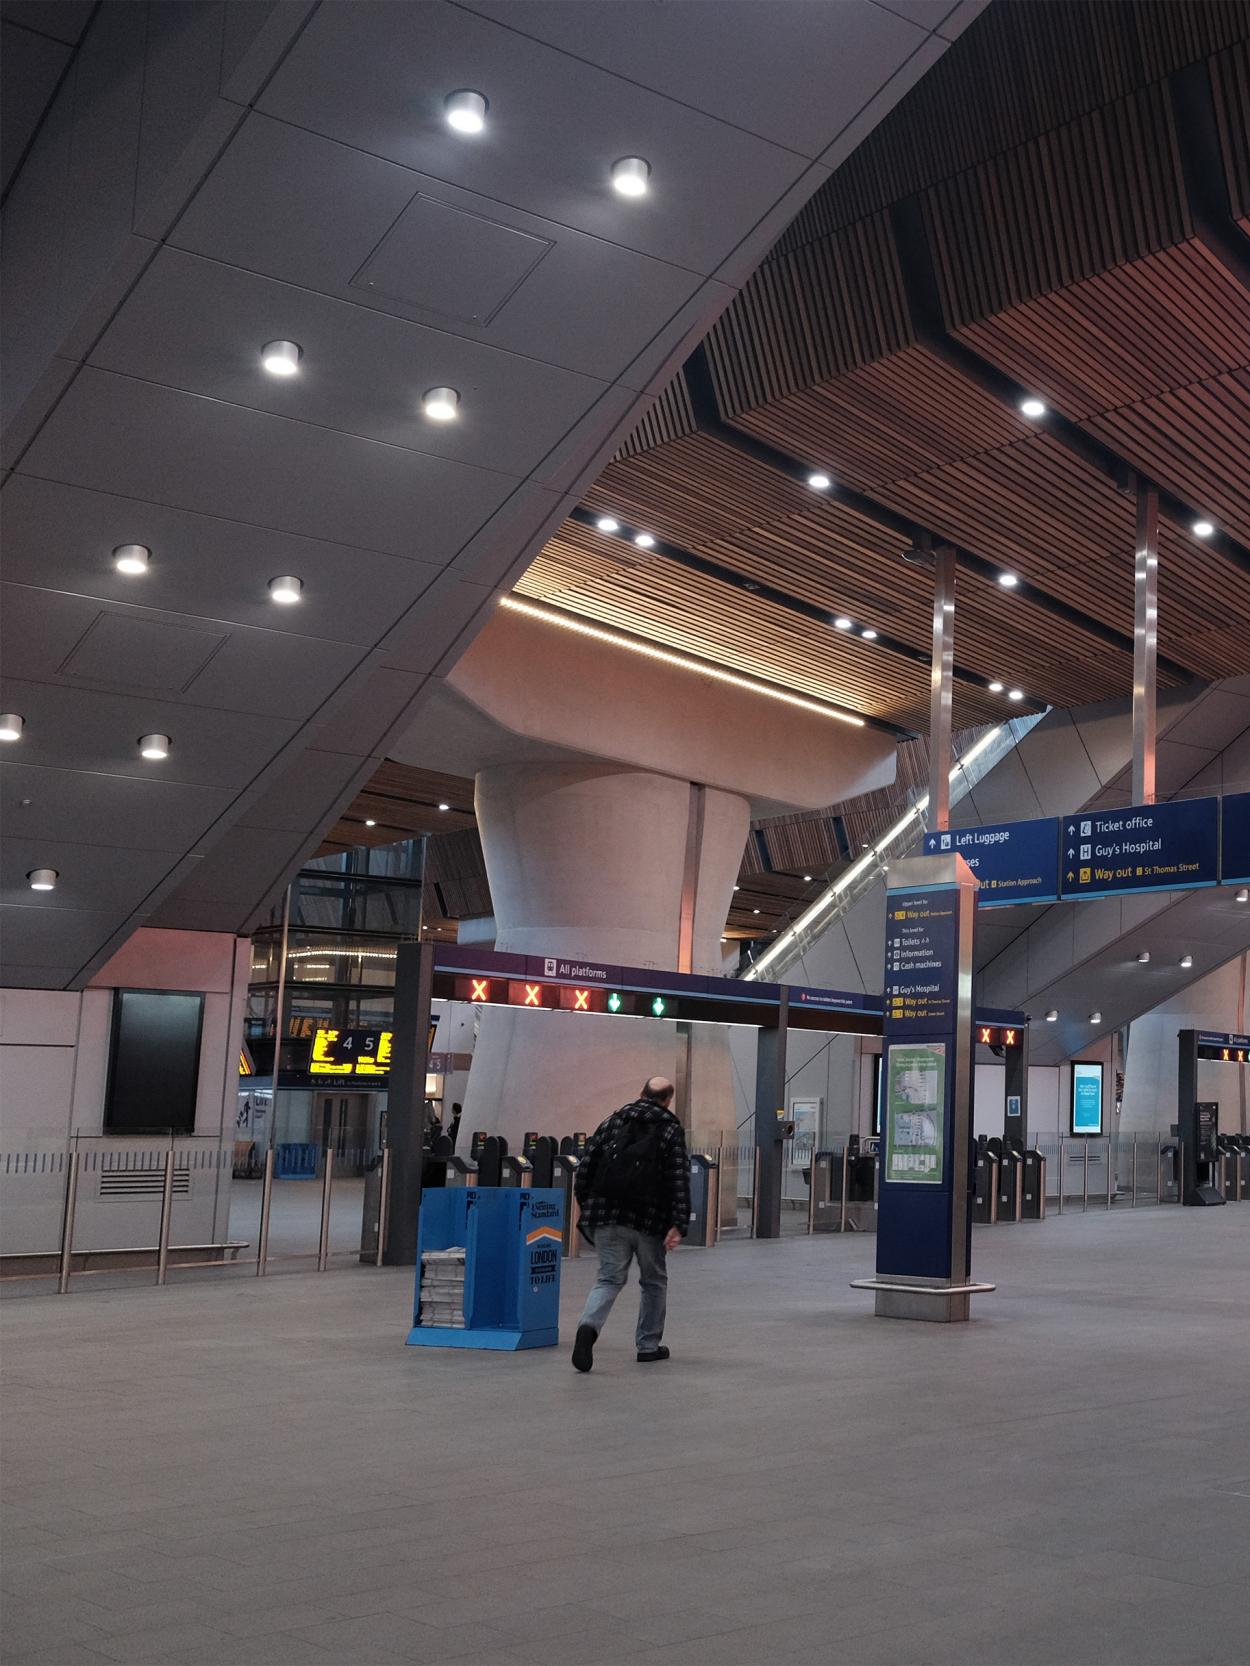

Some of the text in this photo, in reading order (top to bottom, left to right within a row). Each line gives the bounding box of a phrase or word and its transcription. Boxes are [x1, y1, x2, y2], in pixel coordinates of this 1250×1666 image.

[1095, 816, 1153, 833] Ticket office
[956, 831, 1010, 846] Left Luggage
[1095, 838, 1162, 858] Guy's Hospital
[1094, 863, 1199, 881] Way out St Thomas Street
[998, 880, 1016, 888] Station
[1017, 877, 1042, 887] Approach
[907, 911, 919, 920] Way
[902, 938, 920, 946] Toilets
[901, 949, 933, 958] Information
[559, 964, 607, 979] All platforms
[901, 961, 941, 970] Cash machines
[900, 984, 940, 995] Guy's Hospital
[904, 998, 917, 1007] Way
[917, 997, 928, 1005] out
[904, 1010, 916, 1019] Way
[342, 1036, 353, 1050] 4
[364, 1037, 374, 1050] 5
[530, 1249, 557, 1265] LONDON
